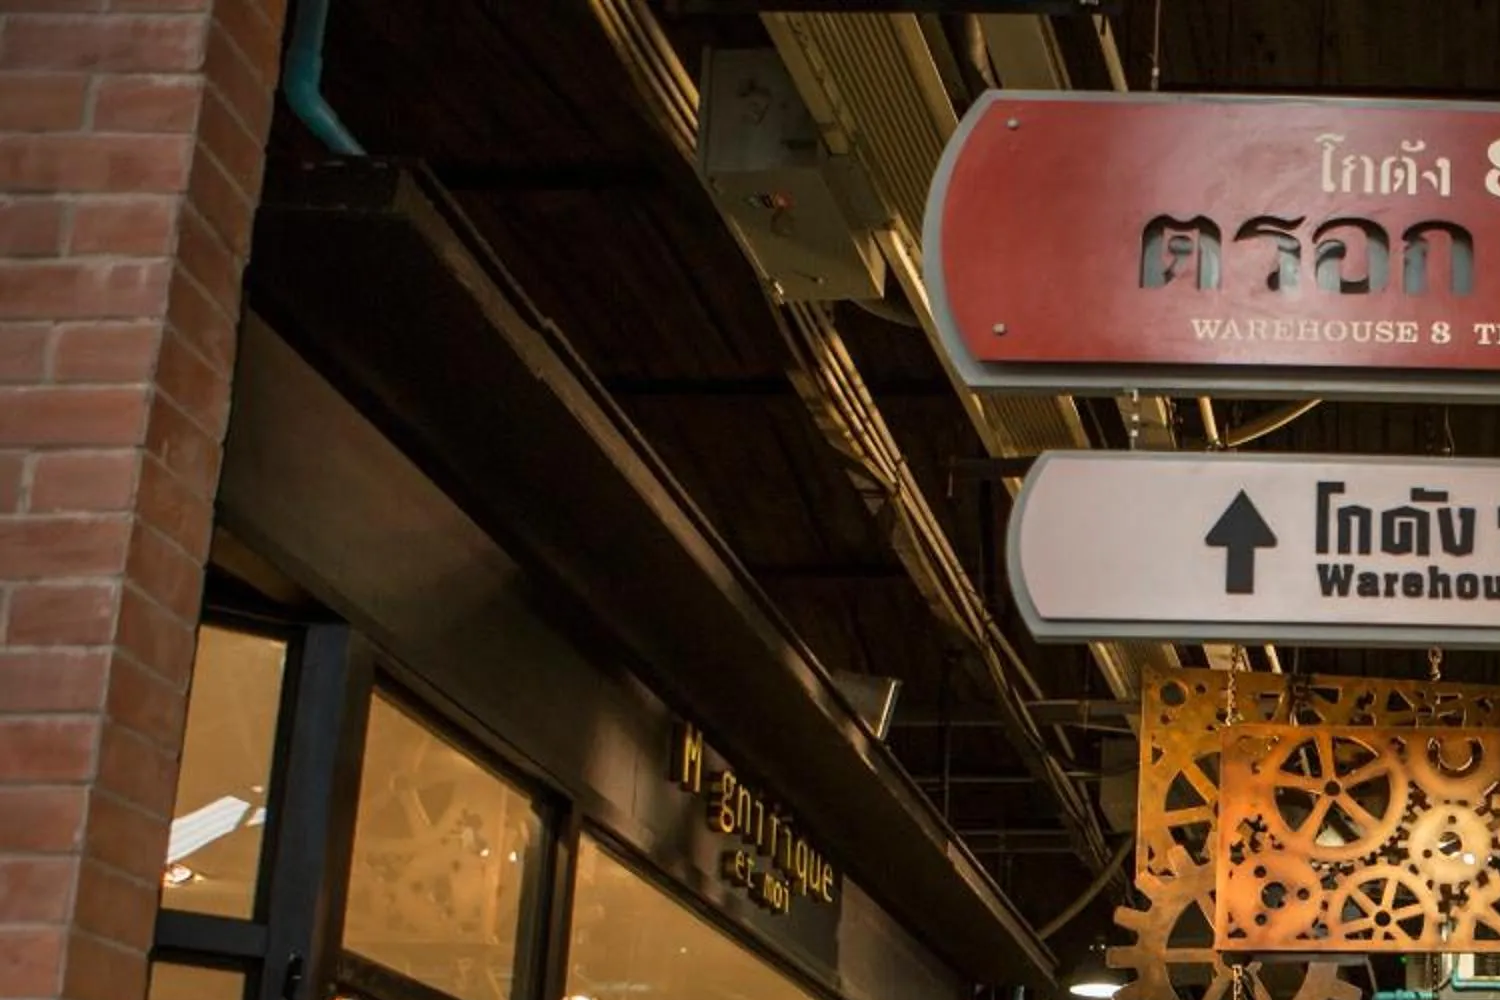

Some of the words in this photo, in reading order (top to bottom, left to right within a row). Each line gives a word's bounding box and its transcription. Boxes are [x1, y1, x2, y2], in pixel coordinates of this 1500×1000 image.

[1314, 133, 1451, 196] โกดัง
[1139, 213, 1475, 295] ตรอก
[1190, 318, 1419, 344] WAREHOUSE
[1431, 322, 1452, 345] 8
[1315, 481, 1477, 557] โกดัง
